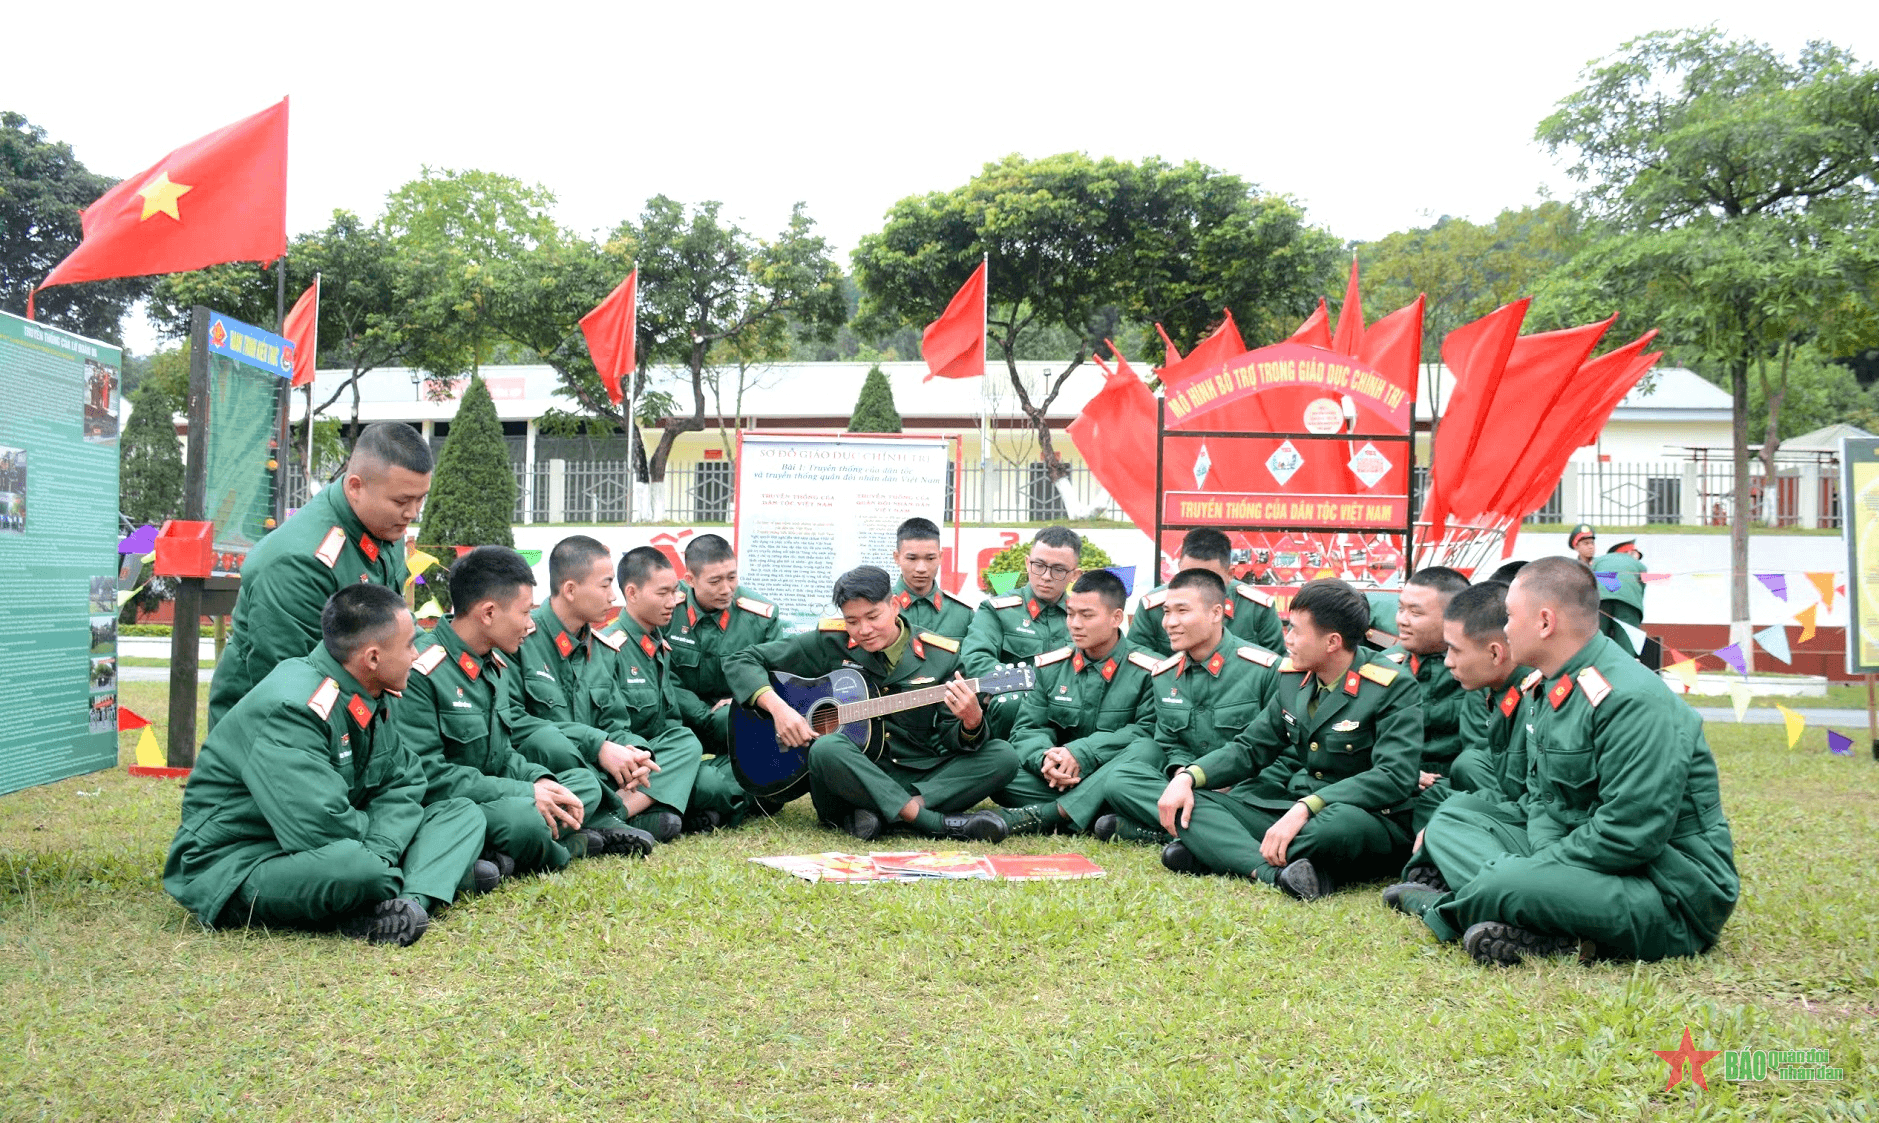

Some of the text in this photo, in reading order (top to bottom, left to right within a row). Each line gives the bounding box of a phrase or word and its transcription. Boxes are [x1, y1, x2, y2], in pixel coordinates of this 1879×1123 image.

[1167, 390, 1192, 418] MÔ
[1186, 378, 1218, 408] HÌNH
[1233, 362, 1257, 391] TRỢ
[1257, 360, 1295, 384] TRONG
[1298, 356, 1325, 382] GIÁO
[1326, 363, 1351, 390] DỤC
[1350, 369, 1387, 400] CHÍNH
[1383, 383, 1406, 413] TRỊ
[760, 449, 775, 458] SƠ
[778, 447, 797, 458] ĐỒ
[799, 449, 830, 459] GIÁO
[833, 451, 857, 461] DỤC
[863, 450, 906, 462] CHÍNH
[765, 471, 792, 480] truyền
[794, 471, 818, 480] thống
[819, 473, 841, 482] quân
[843, 472, 856, 481] đội
[808, 464, 836, 474] Truyền
[839, 464, 862, 474] thống
[1180, 497, 1393, 524] TRUYỀN THỐNG CỦA DÂN TỘC VIỆT NAM
